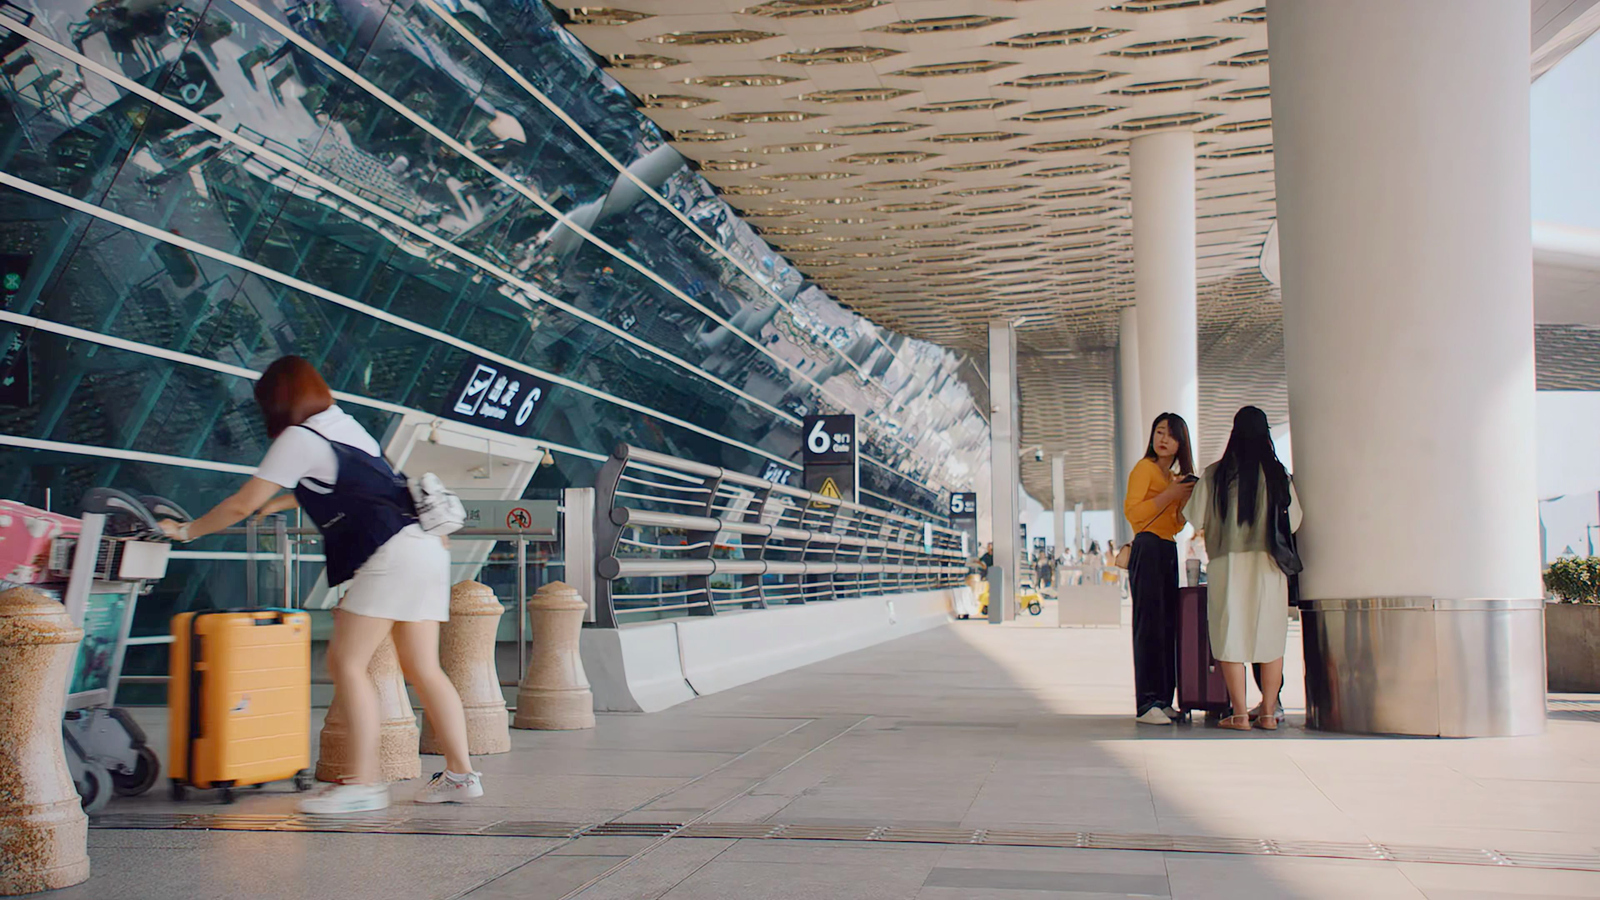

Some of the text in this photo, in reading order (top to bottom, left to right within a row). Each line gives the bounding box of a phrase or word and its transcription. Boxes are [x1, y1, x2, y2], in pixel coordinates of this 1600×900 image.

[515, 387, 541, 426] 6
[808, 420, 831, 454] 6
[950, 494, 964, 514] 5
